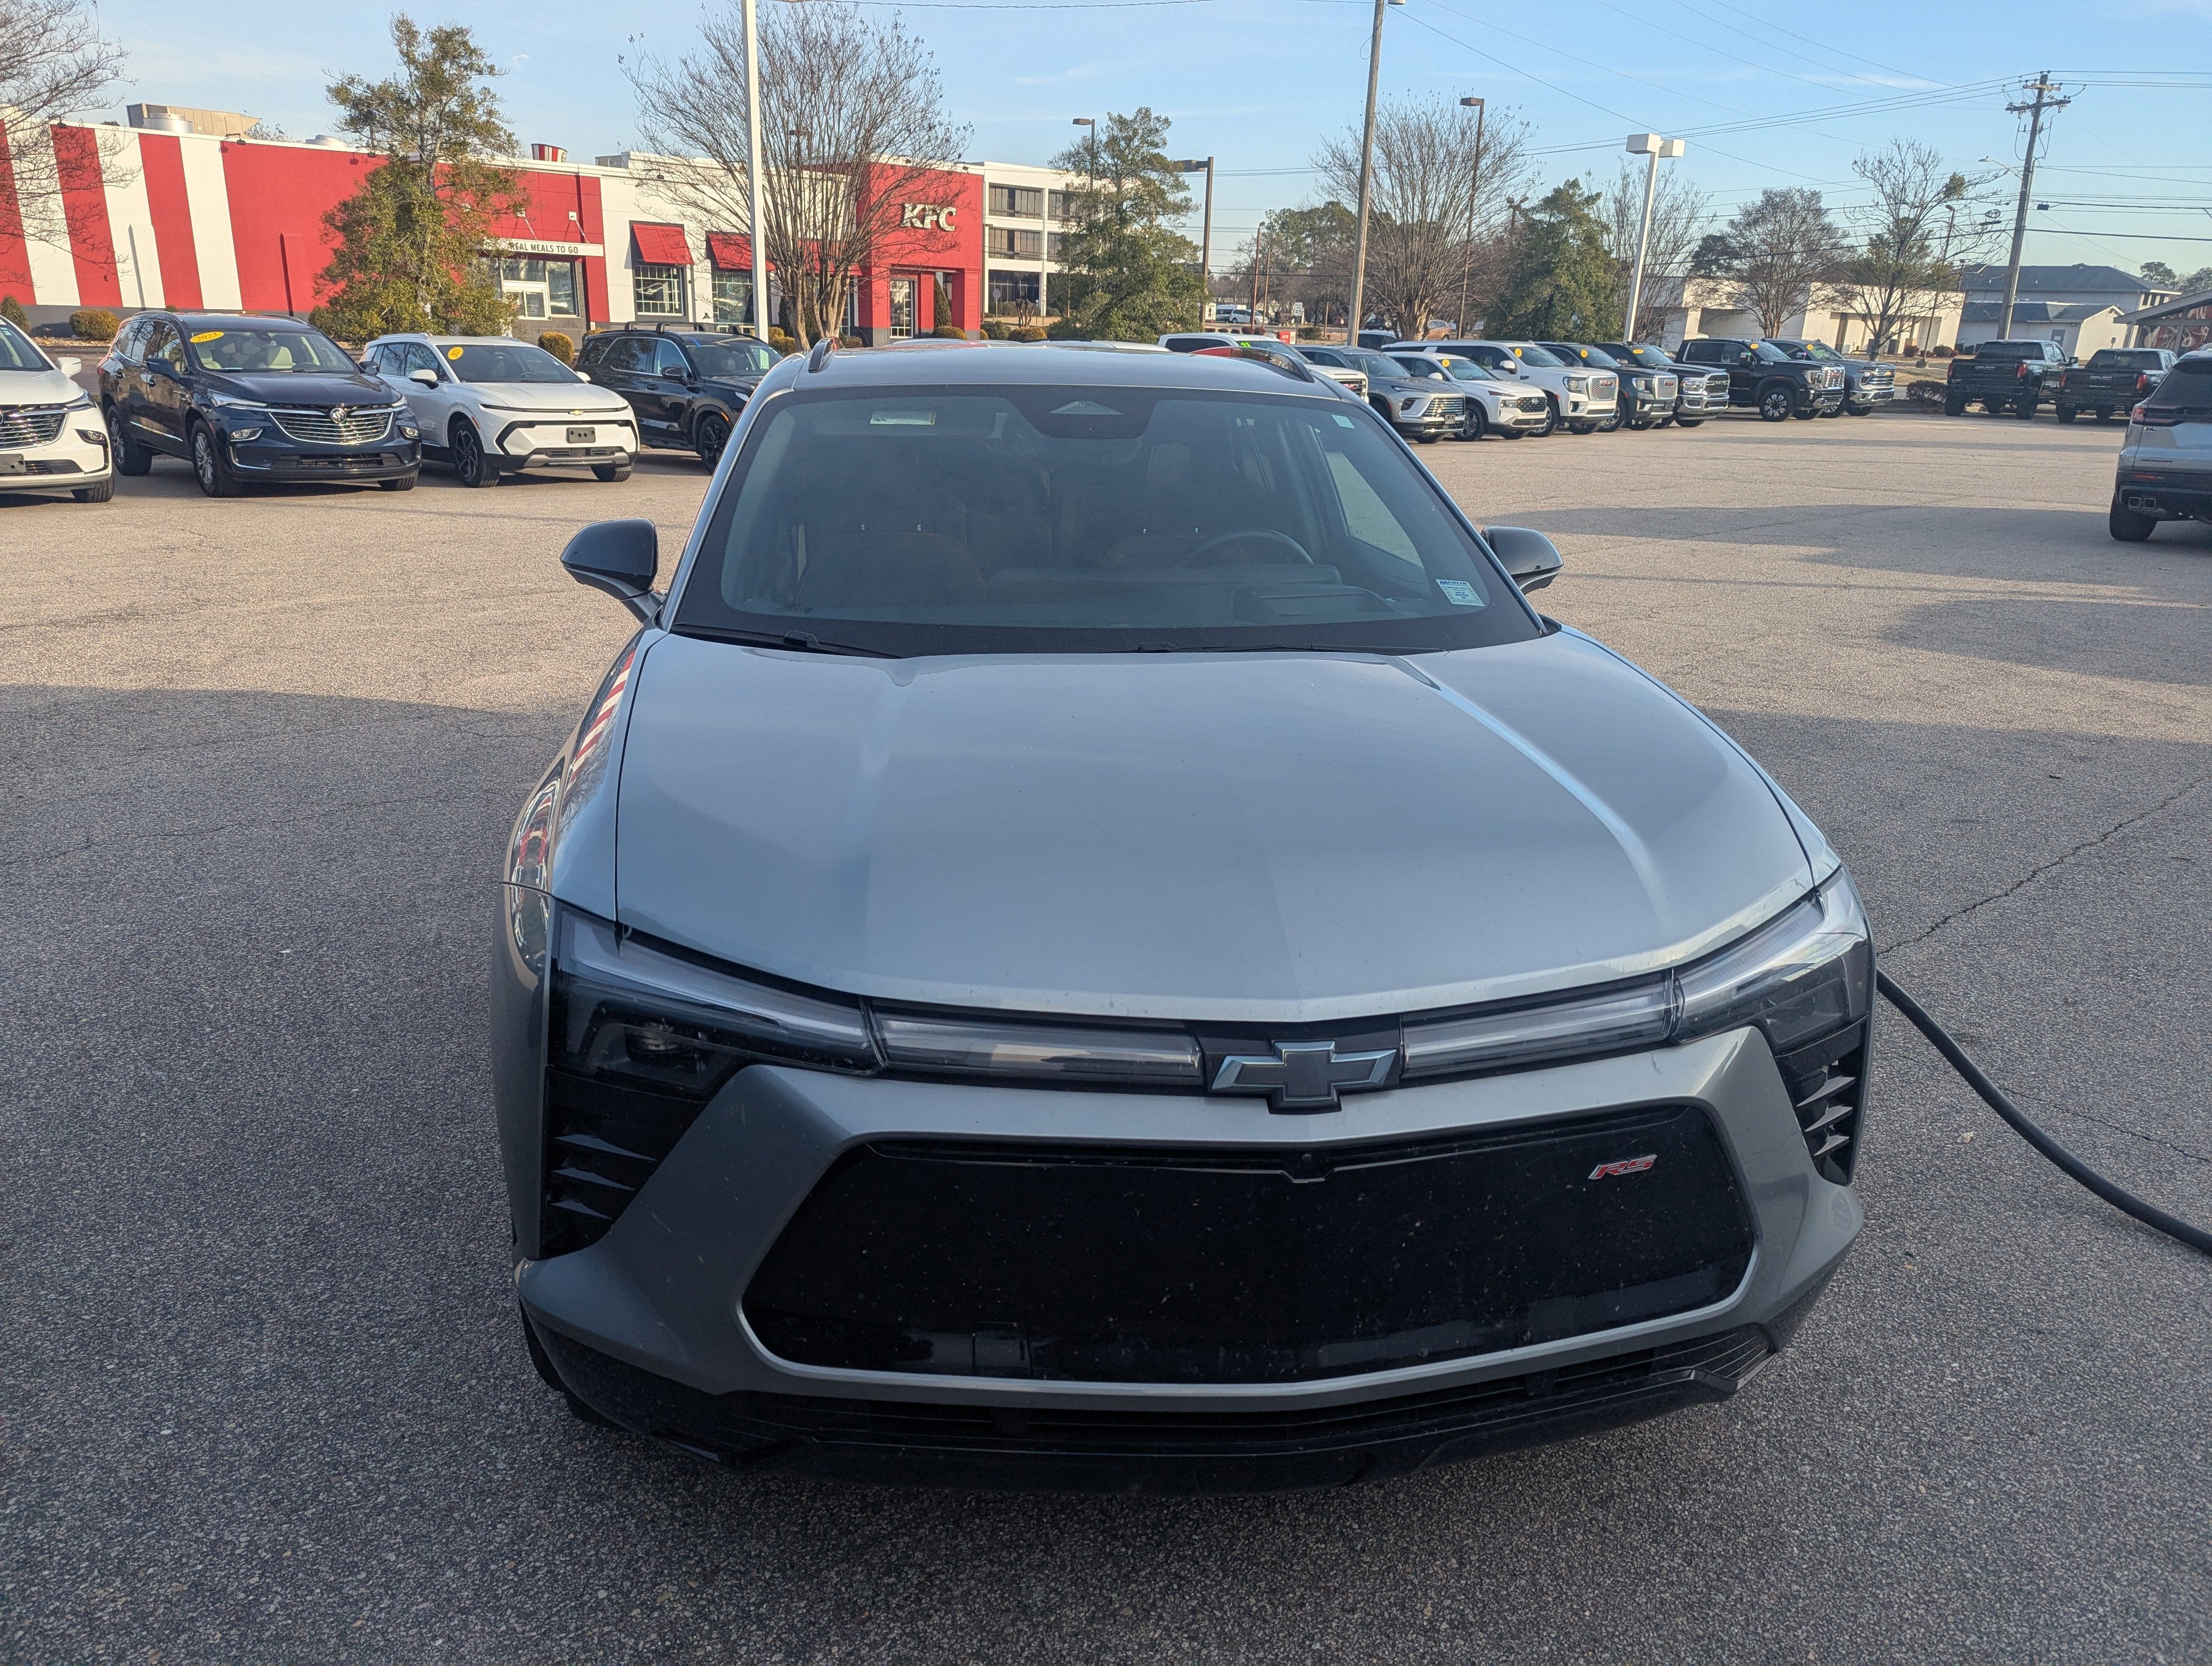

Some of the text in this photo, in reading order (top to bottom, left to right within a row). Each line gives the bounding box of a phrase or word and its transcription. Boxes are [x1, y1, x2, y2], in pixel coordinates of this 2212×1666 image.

[901, 203, 956, 231] KFC
[531, 244, 554, 252] MEALS
[1587, 1154, 1658, 1180] RS
